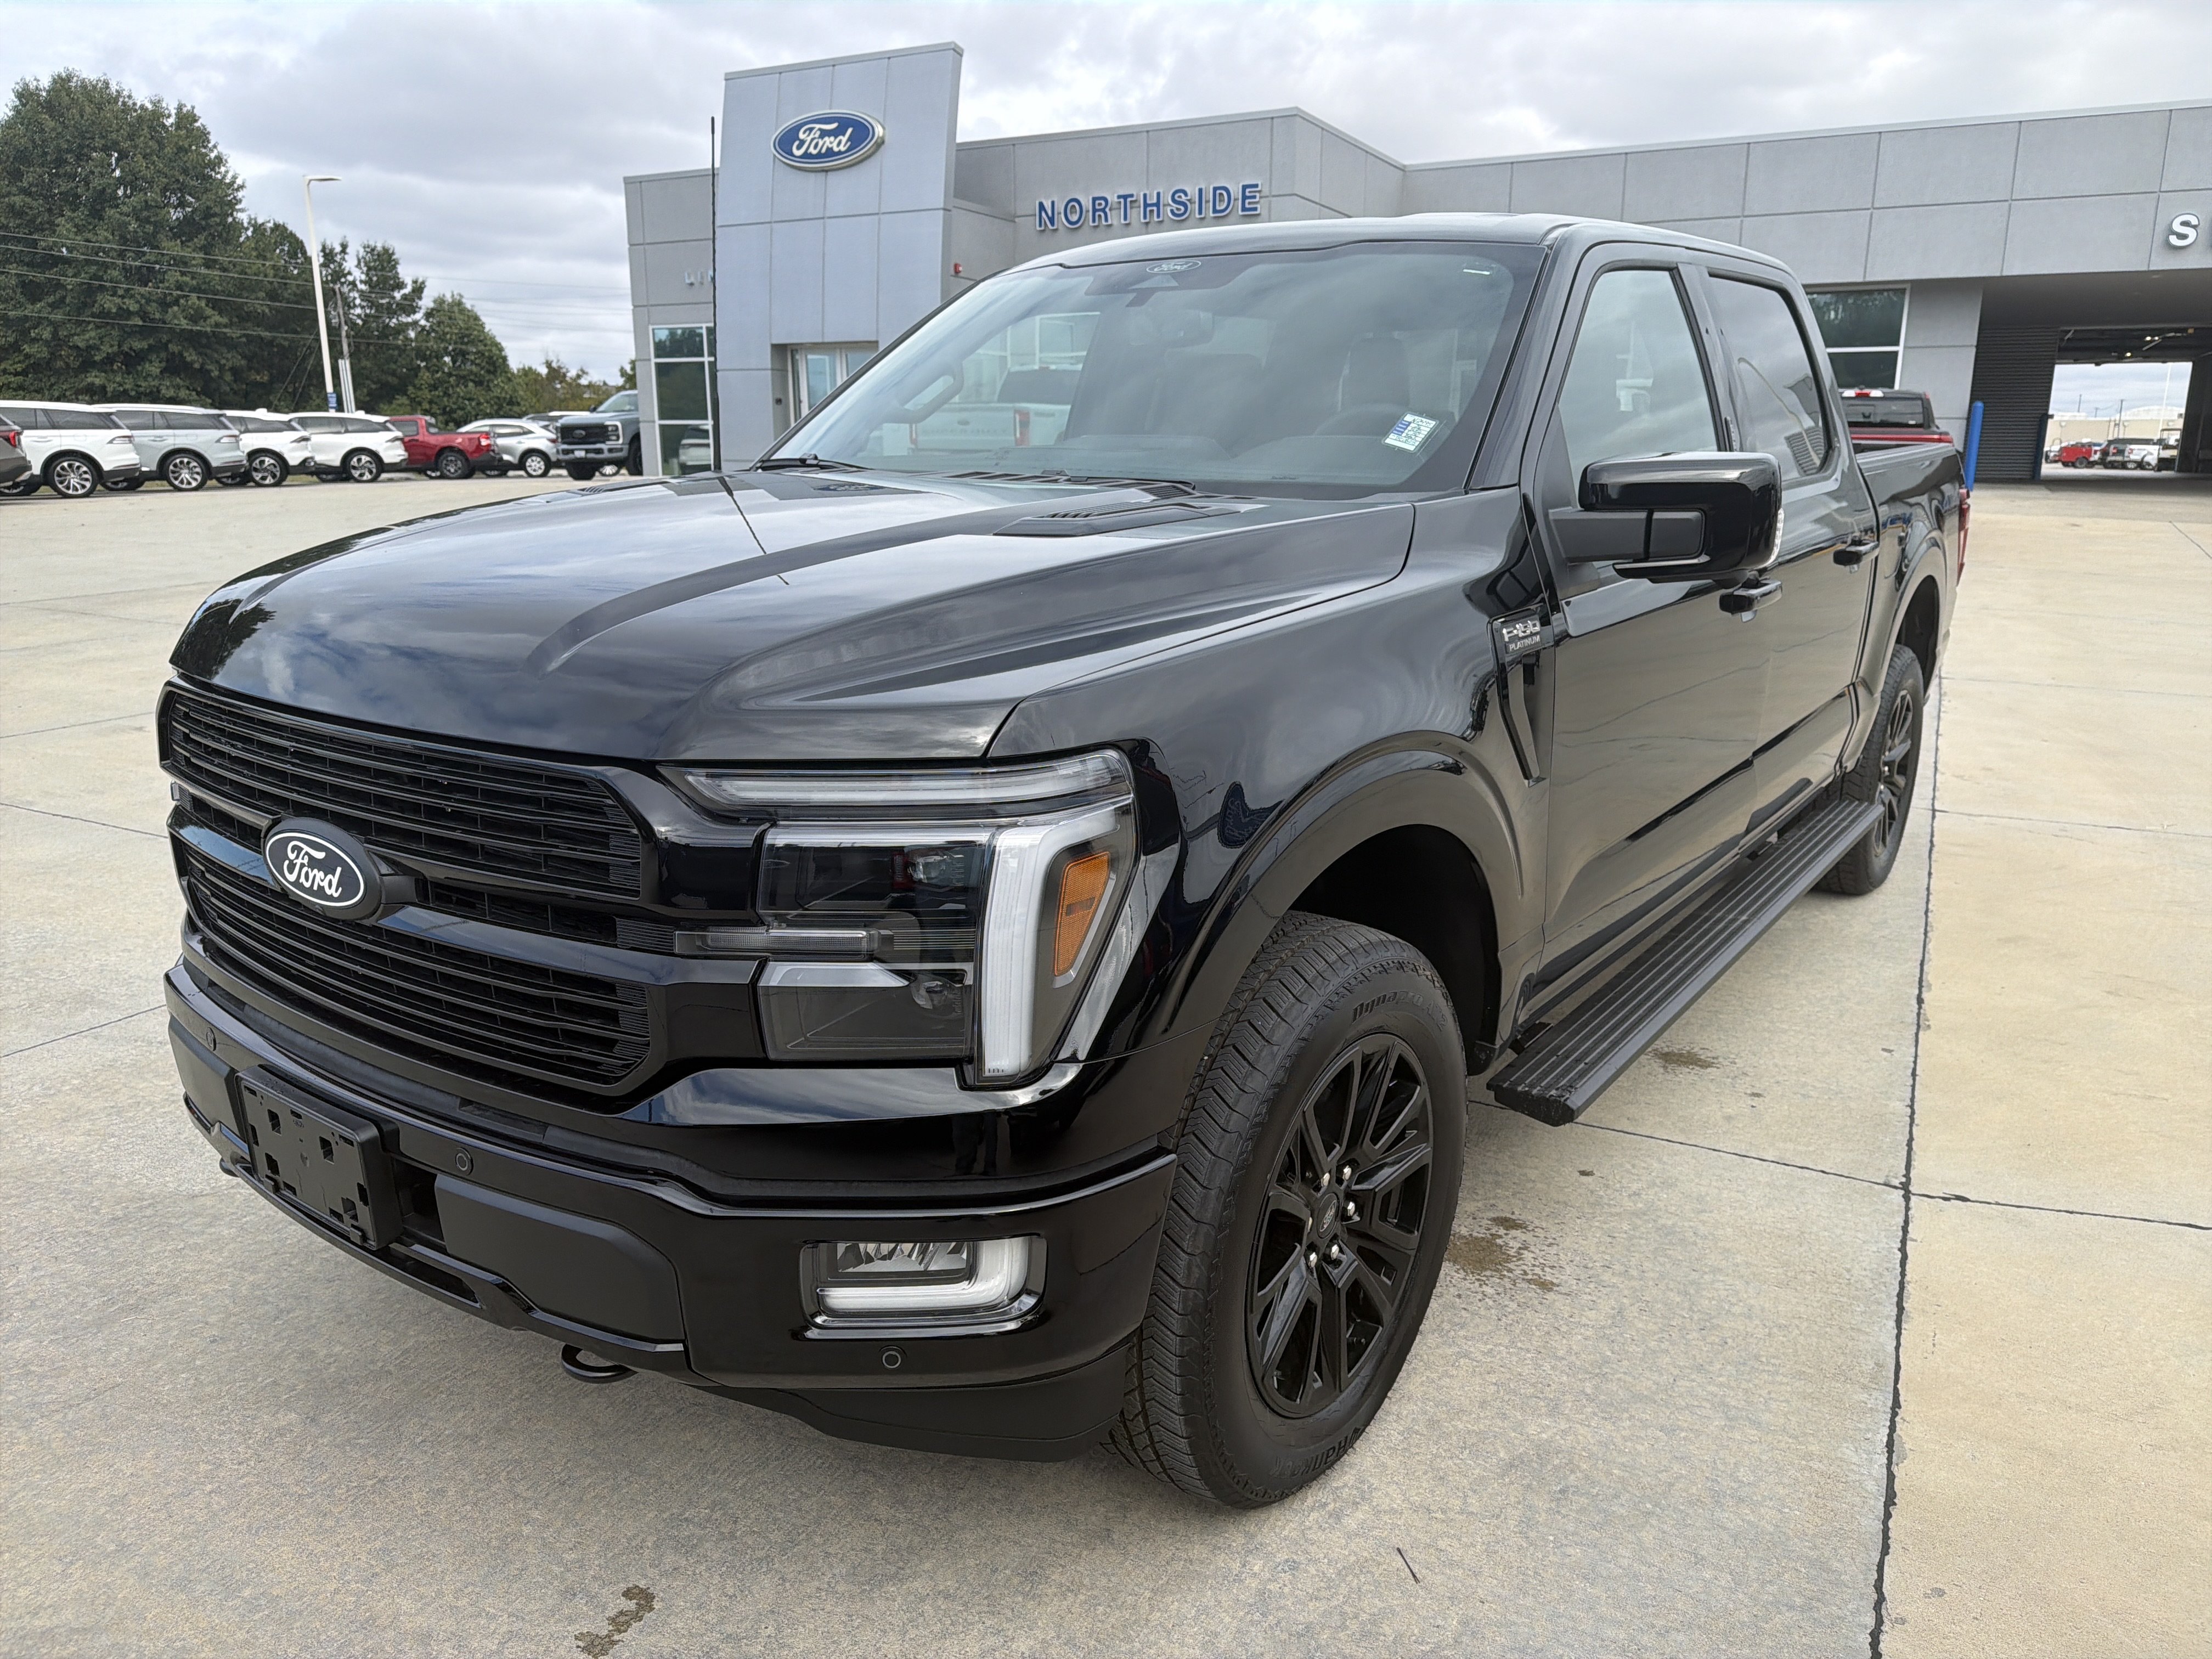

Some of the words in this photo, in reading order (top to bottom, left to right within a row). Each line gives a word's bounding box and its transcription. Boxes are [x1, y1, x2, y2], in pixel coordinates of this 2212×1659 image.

[792, 122, 854, 157] Ford
[1036, 182, 1261, 230] NORTHSIDE
[2168, 212, 2200, 247] S
[1509, 635, 1541, 652] PLATINUM
[283, 840, 342, 898] Ford
